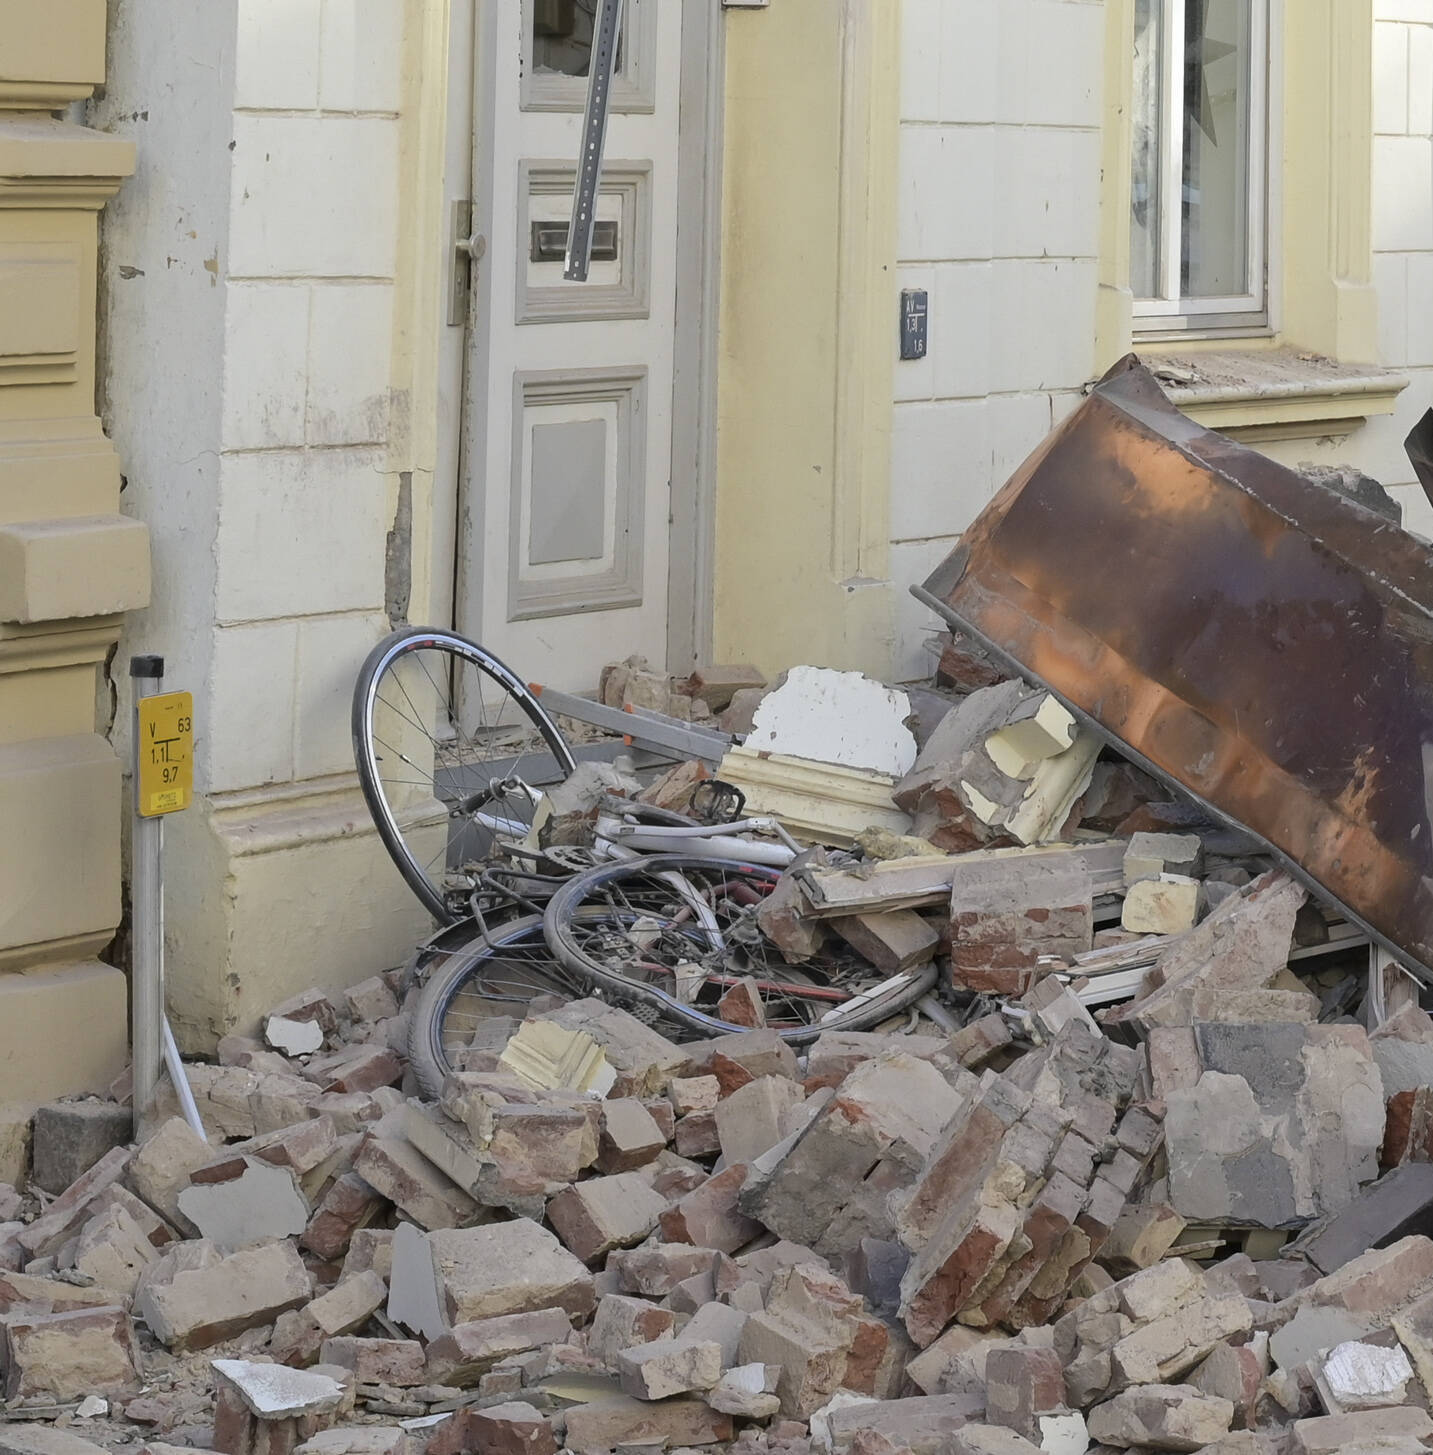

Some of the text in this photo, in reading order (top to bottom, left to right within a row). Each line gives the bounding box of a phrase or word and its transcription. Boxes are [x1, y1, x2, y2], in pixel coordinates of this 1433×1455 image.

[149, 716, 191, 738] V 63
[162, 765, 179, 784] 9,7
